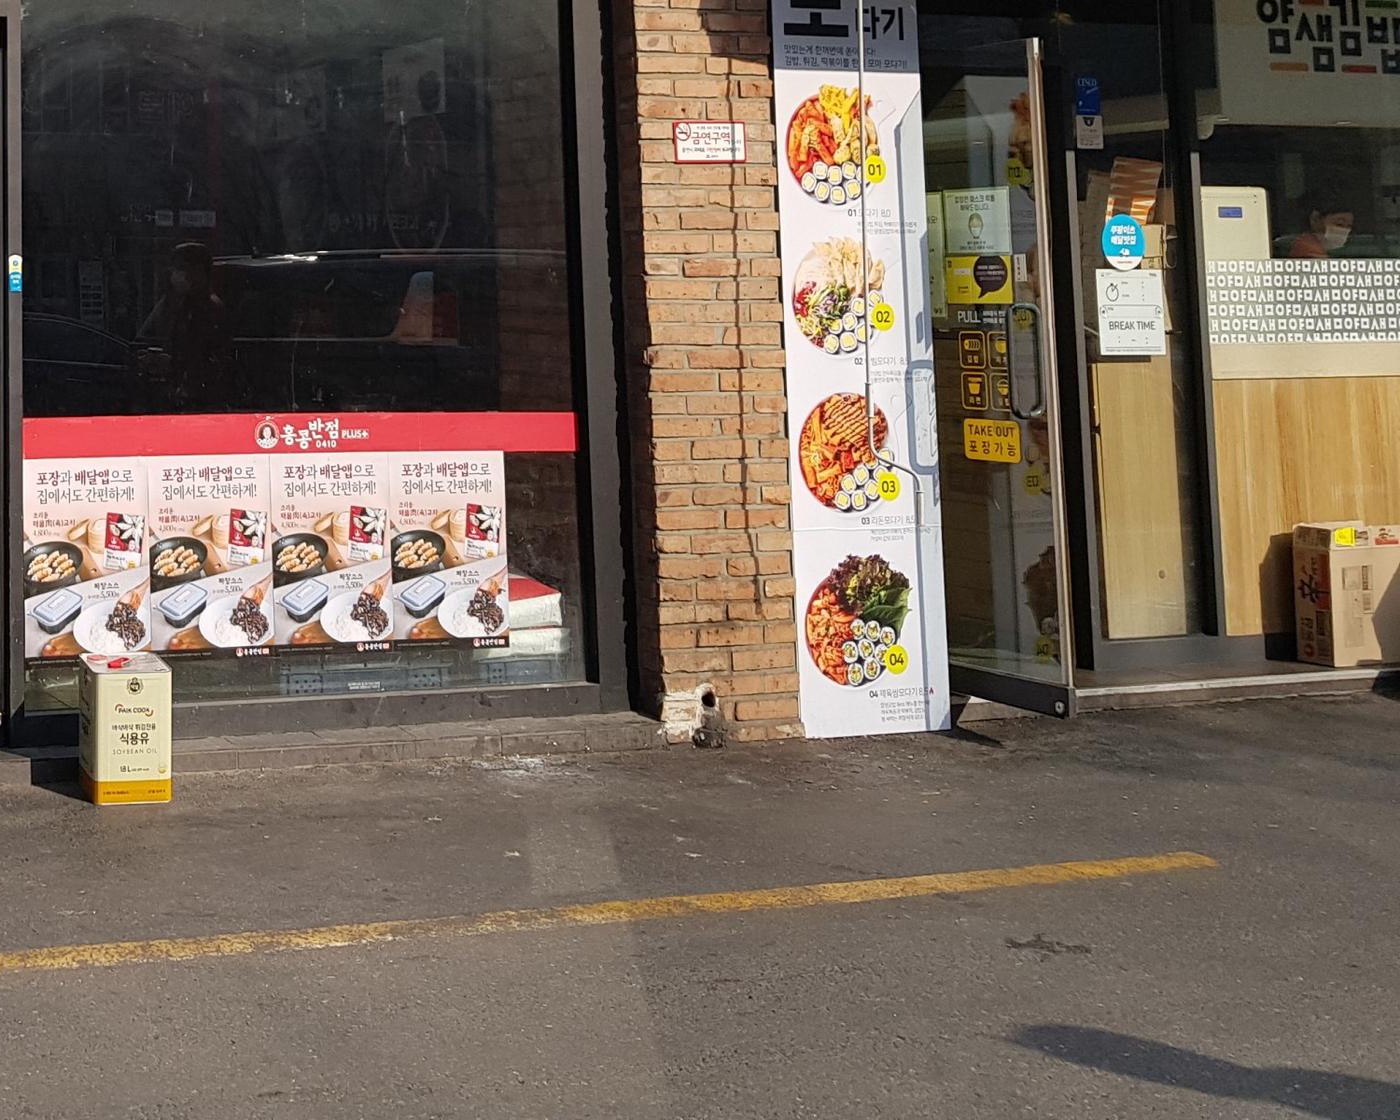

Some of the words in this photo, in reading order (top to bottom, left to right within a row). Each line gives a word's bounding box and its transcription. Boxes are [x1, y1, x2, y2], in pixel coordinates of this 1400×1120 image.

[868, 163, 882, 176] 01
[847, 208, 857, 217] 01
[876, 310, 890, 323] 02
[957, 310, 981, 323] PULL
[1108, 321, 1136, 331] BREAK
[1137, 320, 1156, 331] TIME
[854, 357, 863, 366] 02
[280, 418, 339, 450] 홍콩반점
[968, 424, 993, 437] TAKE
[996, 426, 1016, 438] OUT
[315, 440, 337, 448] 0410
[969, 440, 1017, 457] 포장가능
[161, 467, 197, 482] 포장과
[198, 466, 256, 482] 배달앱으로
[283, 464, 318, 480] 포장과
[319, 463, 376, 479] 배달앱으로
[401, 463, 435, 478] 포장과
[436, 462, 492, 477] 배달앱으로
[36, 470, 72, 486] 포장과
[74, 469, 134, 486] 배달앱으로
[162, 485, 208, 501] 집에서도
[209, 483, 257, 500] 간편하게!
[284, 482, 328, 498] 집에서도
[330, 480, 377, 497] 간편하게!
[402, 479, 445, 495] 집에서도
[447, 478, 492, 494] 간편하게!
[881, 480, 896, 493] 03
[36, 488, 84, 505] 집에서도
[85, 486, 135, 503] 간편하게!
[861, 516, 870, 525] 03
[889, 653, 904, 666] 04
[869, 690, 878, 698] 04
[120, 732, 150, 746] 식용유
